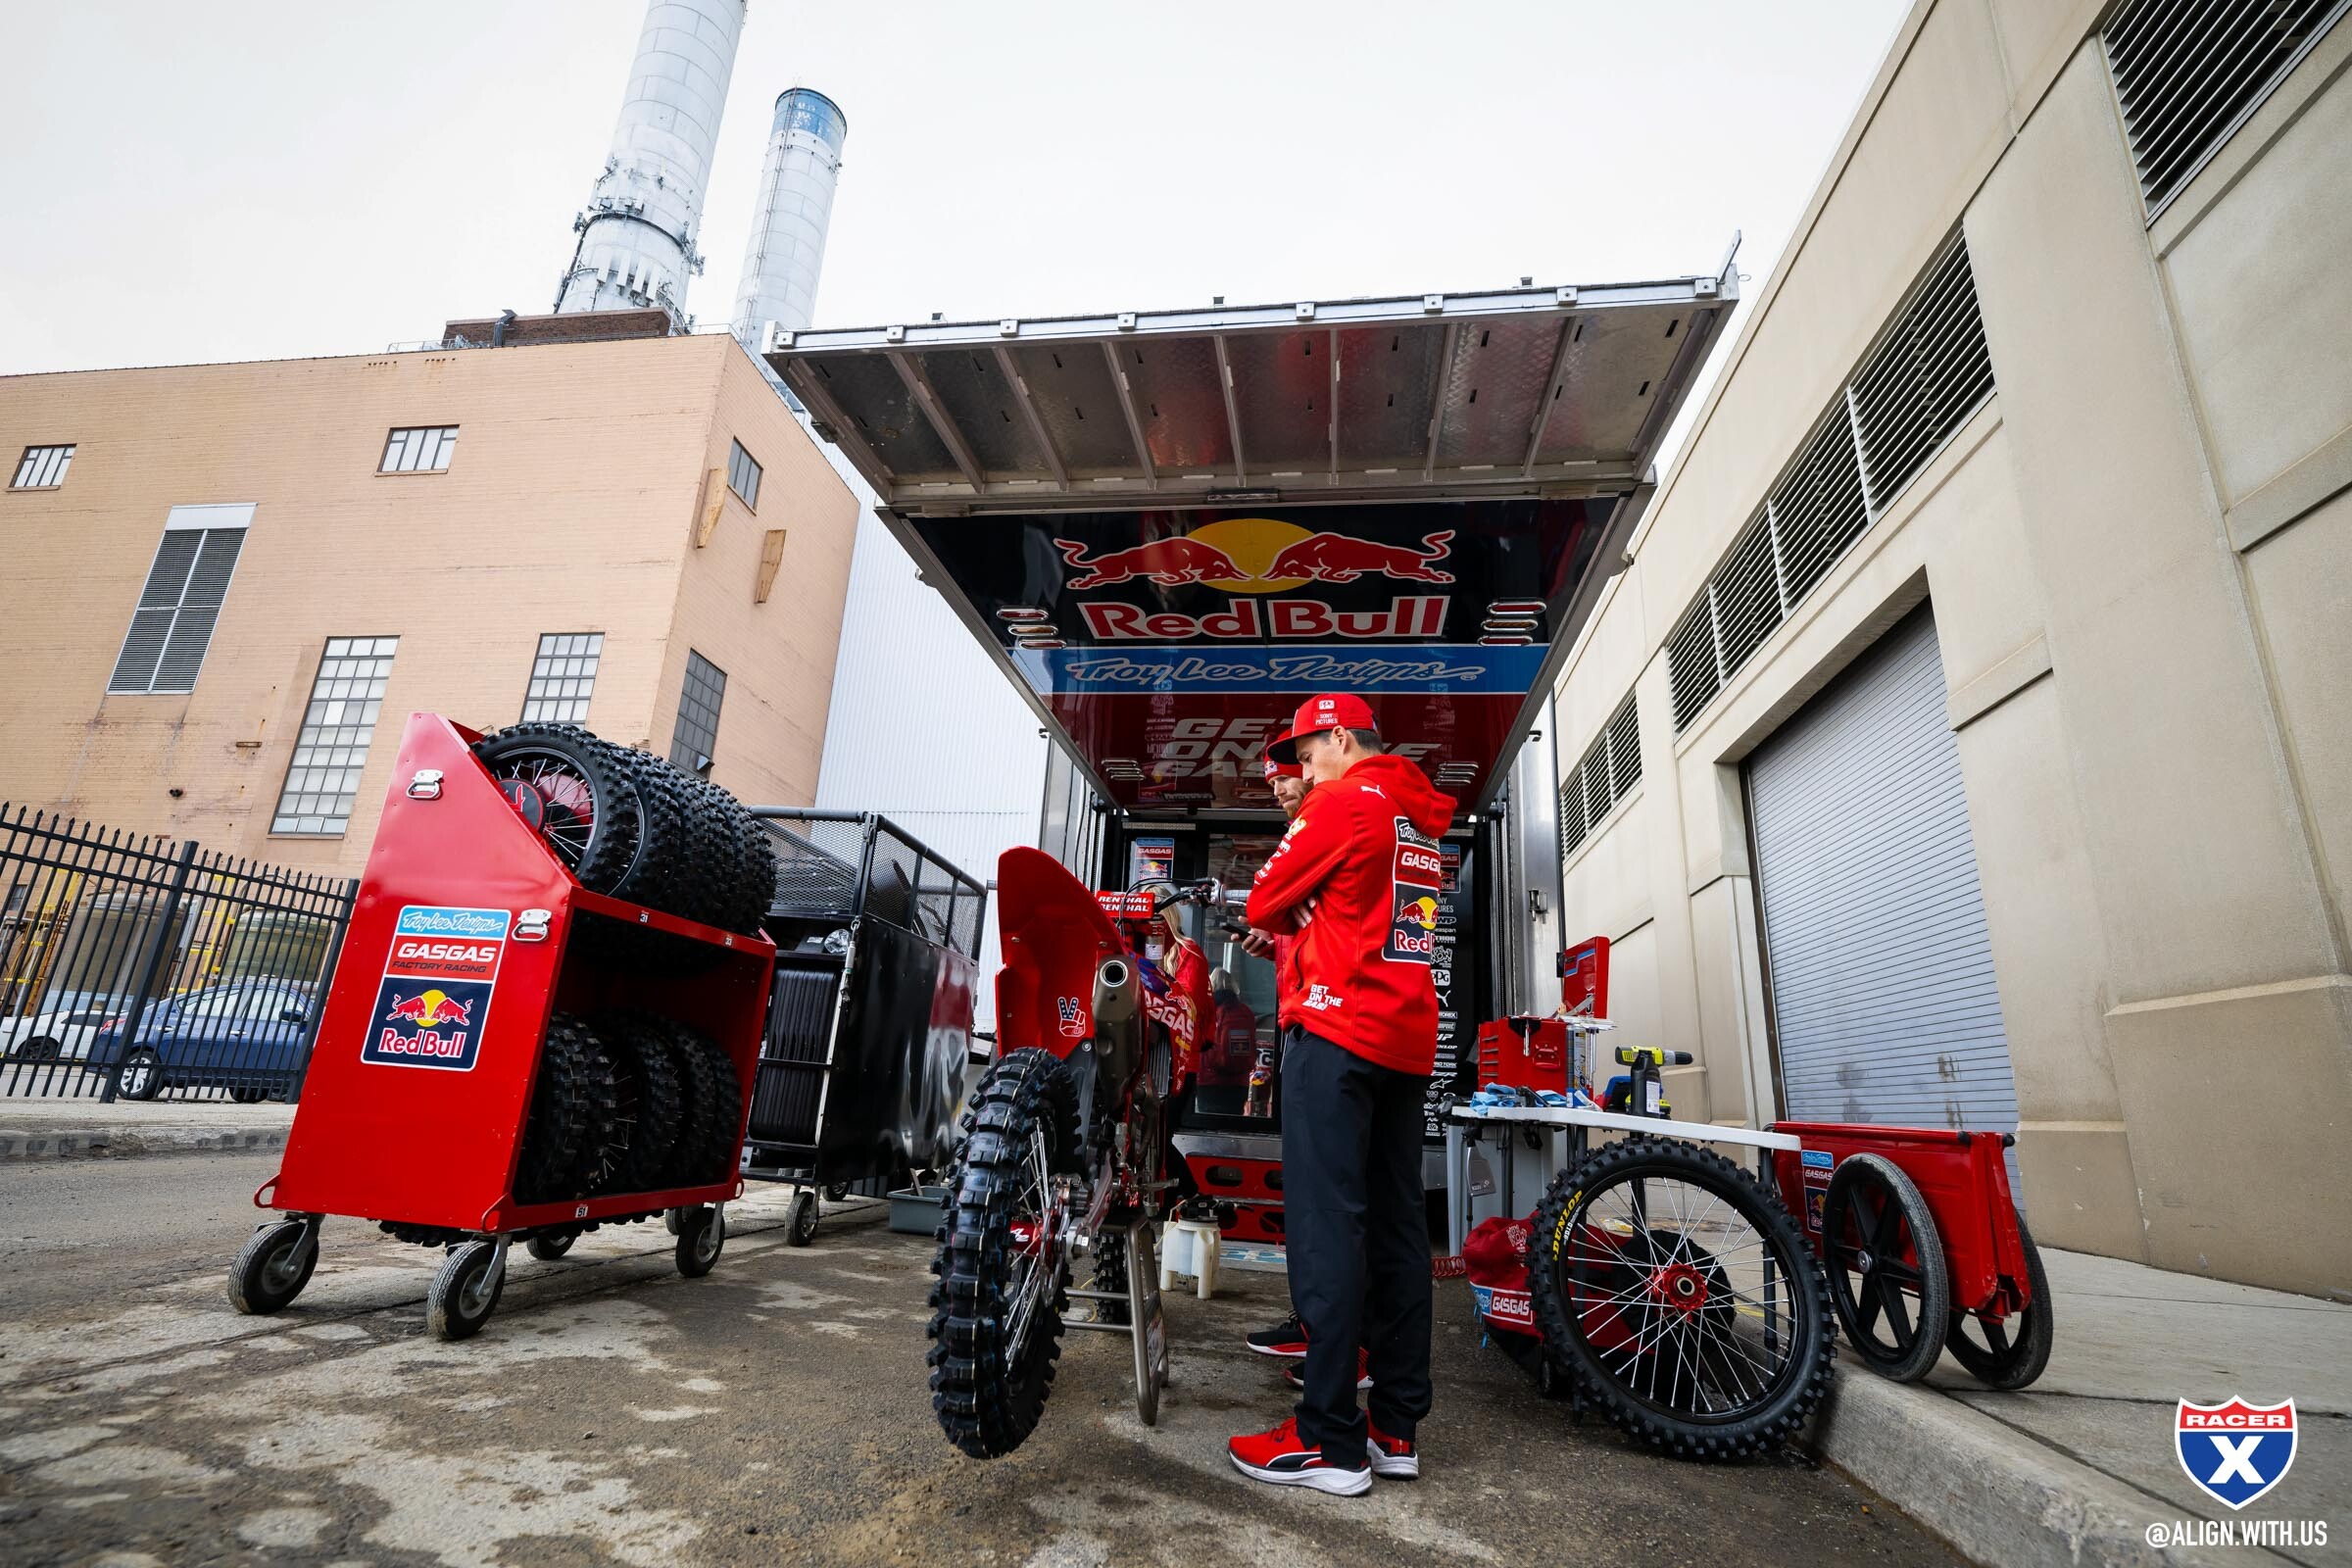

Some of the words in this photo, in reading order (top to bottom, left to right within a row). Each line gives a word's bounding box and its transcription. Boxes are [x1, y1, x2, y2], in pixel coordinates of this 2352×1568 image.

[1076, 598, 1262, 639] Red
[1267, 596, 1450, 638] Bull
[1066, 658, 1174, 685] Troy
[1173, 658, 1267, 681] Lee
[1268, 655, 1486, 684] Designs
[1172, 718, 1294, 738] GE
[1400, 851, 1439, 873] GASG
[403, 911, 428, 932] Troy
[428, 912, 453, 930] Lee
[450, 912, 504, 934] Designs
[397, 943, 497, 962] GASGAS
[1394, 929, 1432, 954] Red
[392, 960, 443, 971] FACTORY
[443, 962, 487, 973] RACING
[1310, 983, 1330, 994] GET
[1308, 993, 1323, 1004] ON
[1324, 995, 1344, 1007] THE
[1145, 987, 1195, 1043] ASGAS
[377, 1028, 423, 1054] Red
[421, 1030, 467, 1058] Bull
[1552, 1190, 1583, 1255] DUNLOP
[1492, 1296, 1530, 1316] GASGAS
